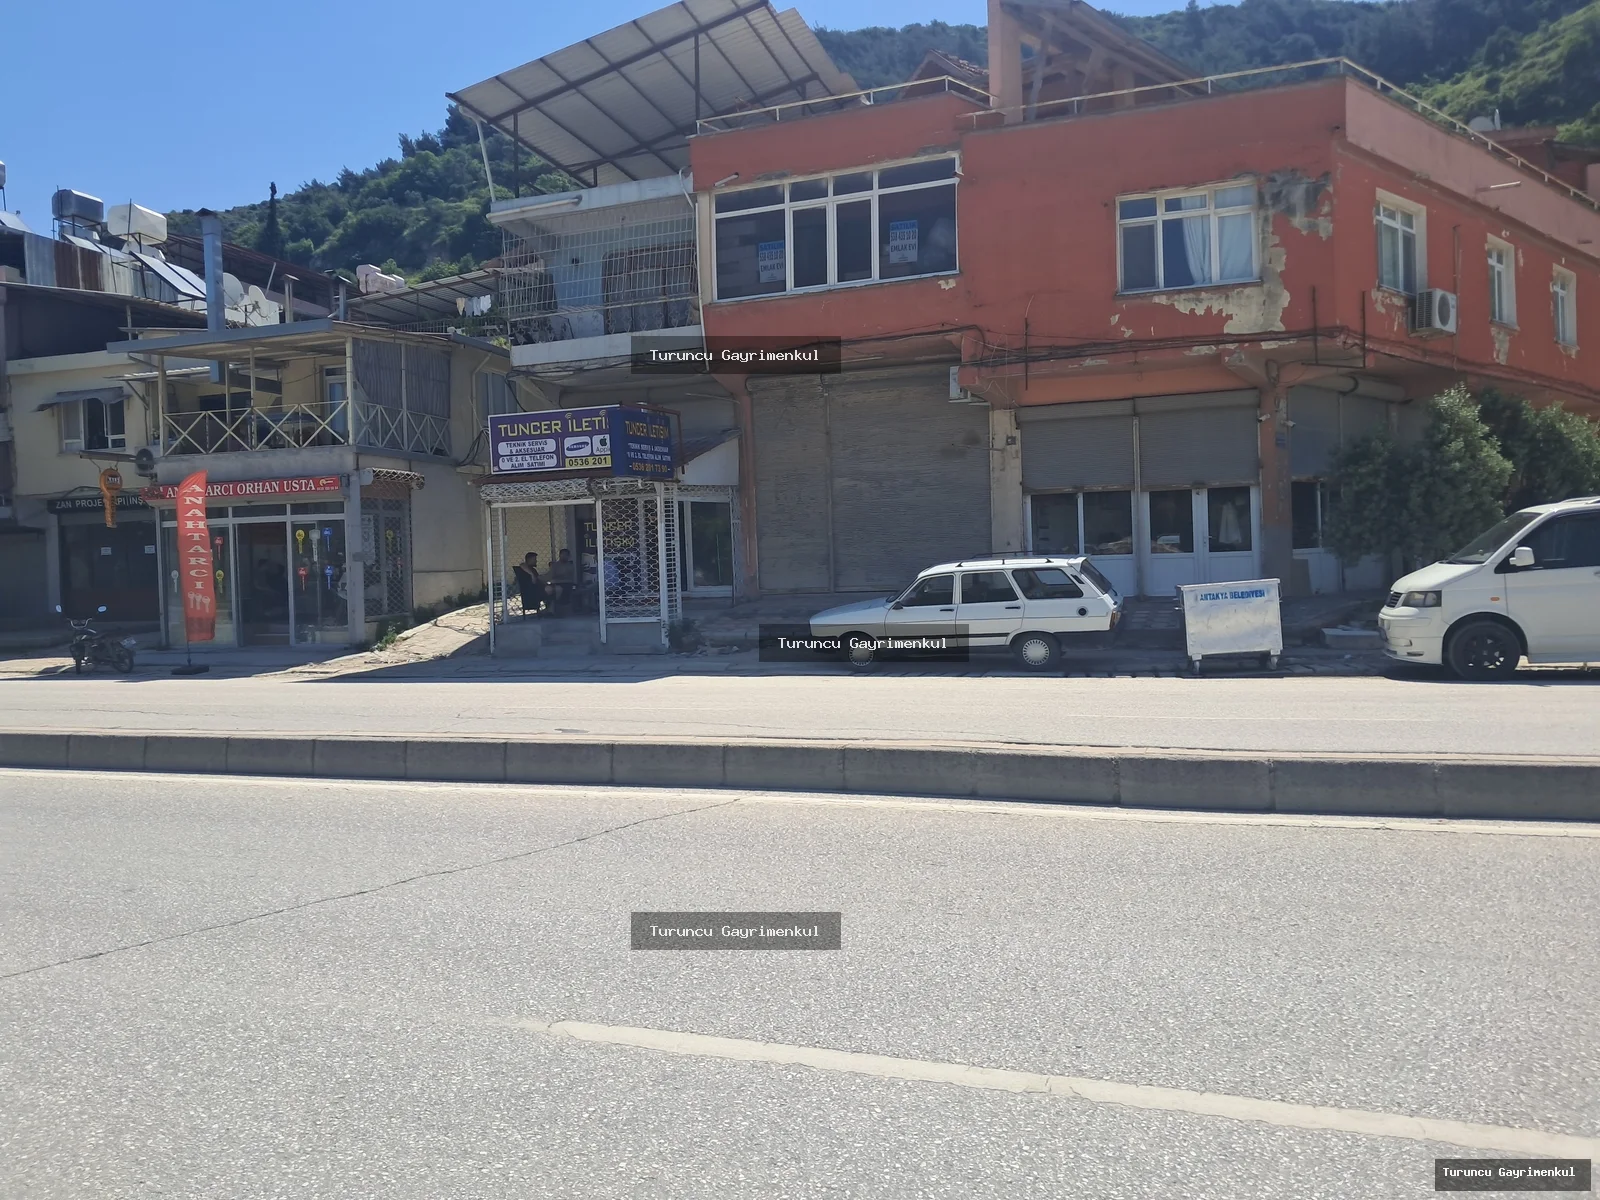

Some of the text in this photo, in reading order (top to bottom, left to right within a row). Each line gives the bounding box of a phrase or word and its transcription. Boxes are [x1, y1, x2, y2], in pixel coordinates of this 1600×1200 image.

[891, 244, 907, 252] EMLAK
[760, 263, 776, 272] EMLAK
[498, 412, 609, 437] TUNCER İLETİ
[568, 456, 607, 467] 0536 201
[237, 480, 280, 496] ORHAN
[283, 479, 316, 492] USTA
[55, 500, 72, 509] ZAN
[75, 498, 103, 508] PROJE
[1200, 591, 1228, 601] ANTAKYA
